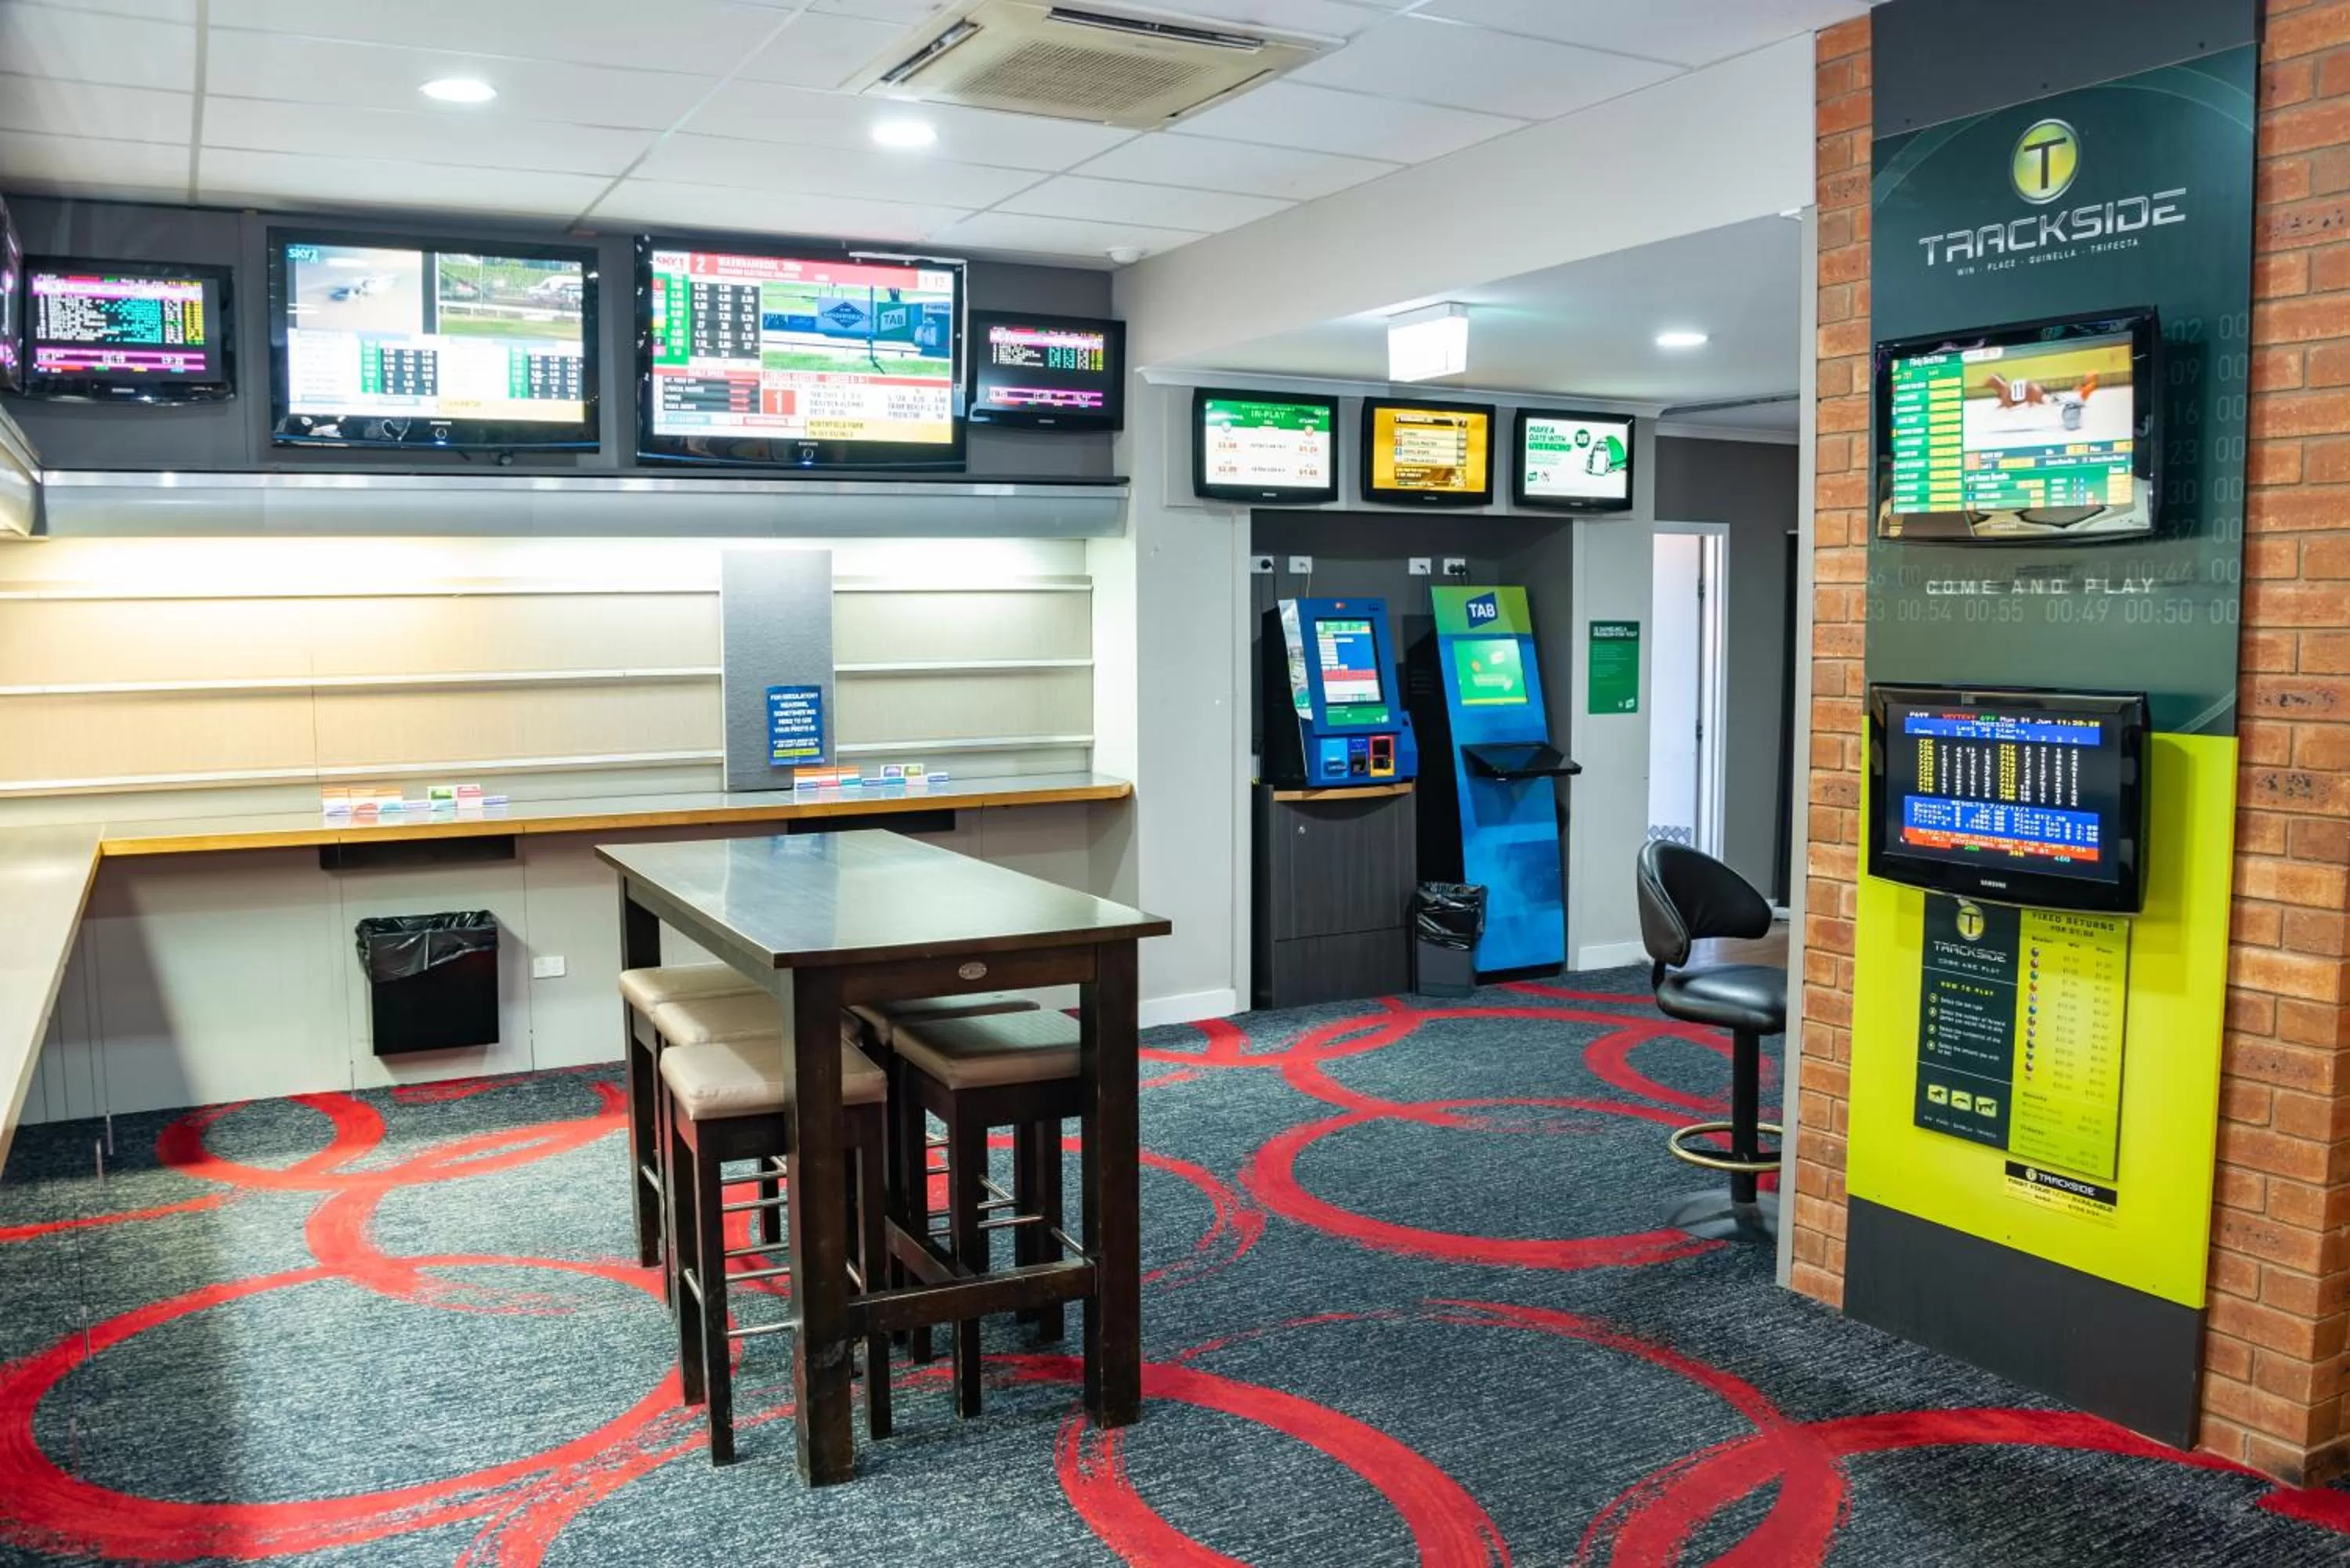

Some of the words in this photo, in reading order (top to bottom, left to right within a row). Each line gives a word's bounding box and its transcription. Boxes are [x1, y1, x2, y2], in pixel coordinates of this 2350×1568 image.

[2024, 137, 2067, 190] T
[1919, 188, 2186, 266] TRACKSIDE
[696, 257, 706, 273] 2
[1957, 265, 1975, 276] WIN
[1987, 259, 2016, 273] PLACE
[2029, 249, 2077, 264] QUINELLA
[2091, 238, 2138, 255] TRIFECTA
[884, 314, 903, 325] TAB
[1528, 425, 1549, 434] MAKE
[1926, 580, 1992, 595] COME
[2011, 579, 2063, 595] AND
[2084, 577, 2153, 594] PLAY
[1468, 602, 1495, 618] TAB
[1897, 598, 1952, 622] 00:54
[1965, 598, 2024, 623] 00:55
[2045, 598, 2109, 623] 00:49
[2124, 598, 2194, 624] 00:50
[1979, 879, 2007, 889] SAMSUNG
[2066, 916, 2114, 931] RETURNS
[1933, 940, 2007, 963] TRACKSIDE
[2038, 1172, 2096, 1196] TRACKSIDE
